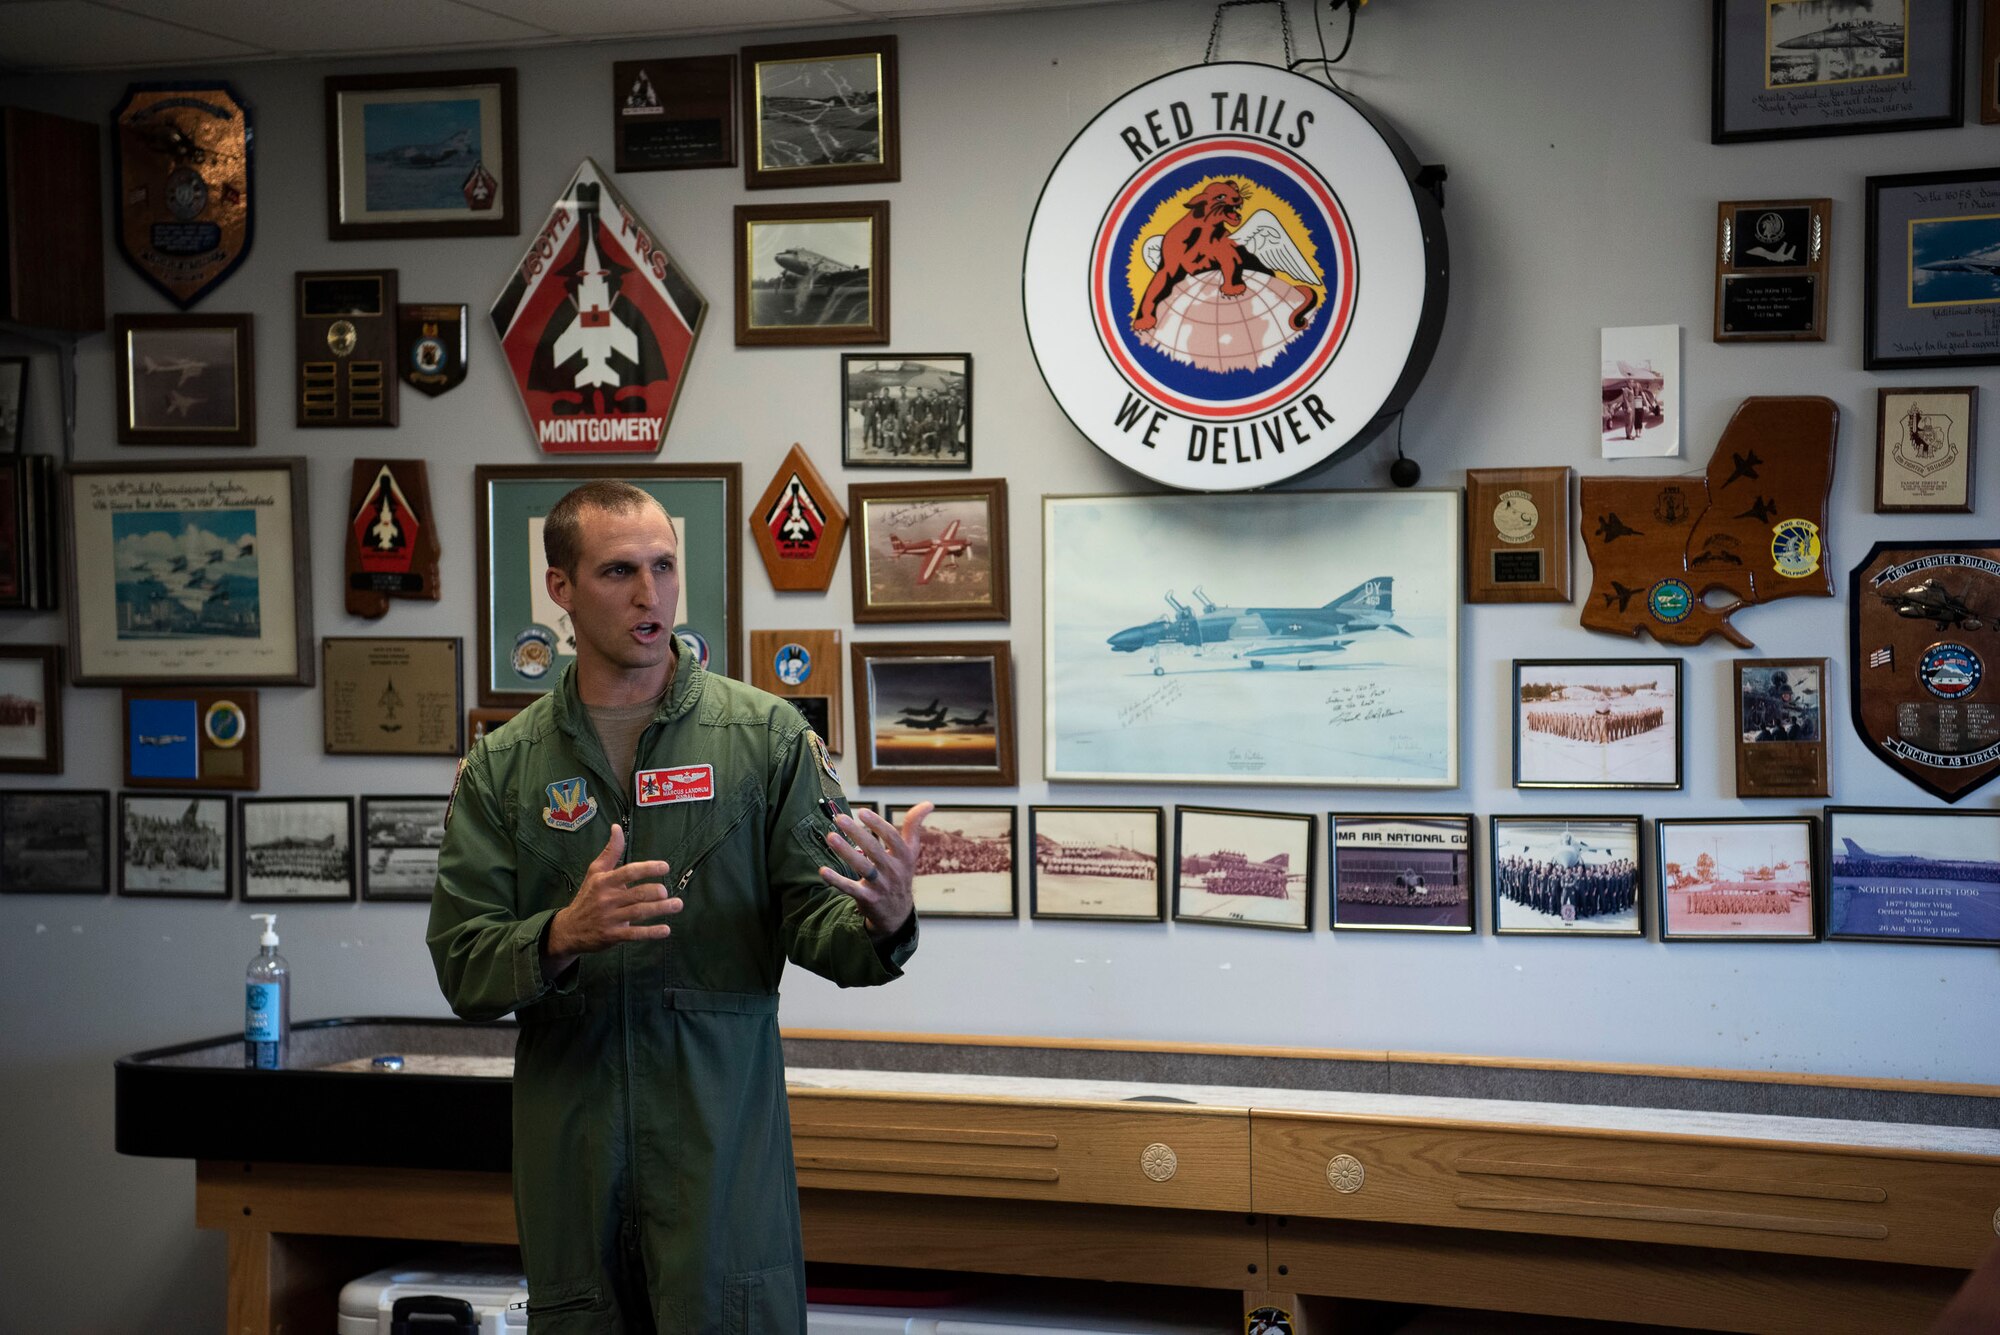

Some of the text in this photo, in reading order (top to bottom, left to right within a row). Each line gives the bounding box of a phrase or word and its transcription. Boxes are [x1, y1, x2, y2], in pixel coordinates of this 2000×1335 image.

[1120, 92, 1315, 163] RED TAILS
[520, 202, 669, 286] 160TH TRS
[539, 416, 662, 444] MONTGOMERY
[1114, 392, 1336, 466] WE DELIVER
[1780, 521, 1793, 530] ANG
[1917, 556, 1957, 571] FIGHTER
[1782, 568, 1811, 577] GULFPORT
[1932, 644, 1966, 655] OPERATION
[1927, 684, 1975, 699] NORTHERN WATCH
[1902, 743, 2000, 767] INCIRLIK AB TURKEY
[662, 786, 709, 797] MARCUS LANDRUM
[556, 820, 575, 829] COMBAT
[575, 806, 595, 825] COMMAND
[1361, 831, 1383, 842] AIR
[1386, 832, 1446, 844] NATIONAL
[1450, 834, 1467, 845] GU
[1858, 885, 1980, 897] NORTHERN LIGHTS 1996
[1905, 900, 1931, 909] Fighter
[1932, 902, 1953, 910] Wing
[1904, 917, 1934, 926] Norway
[1890, 925, 1906, 933] Aug
[1923, 926, 1939, 935] Sep
